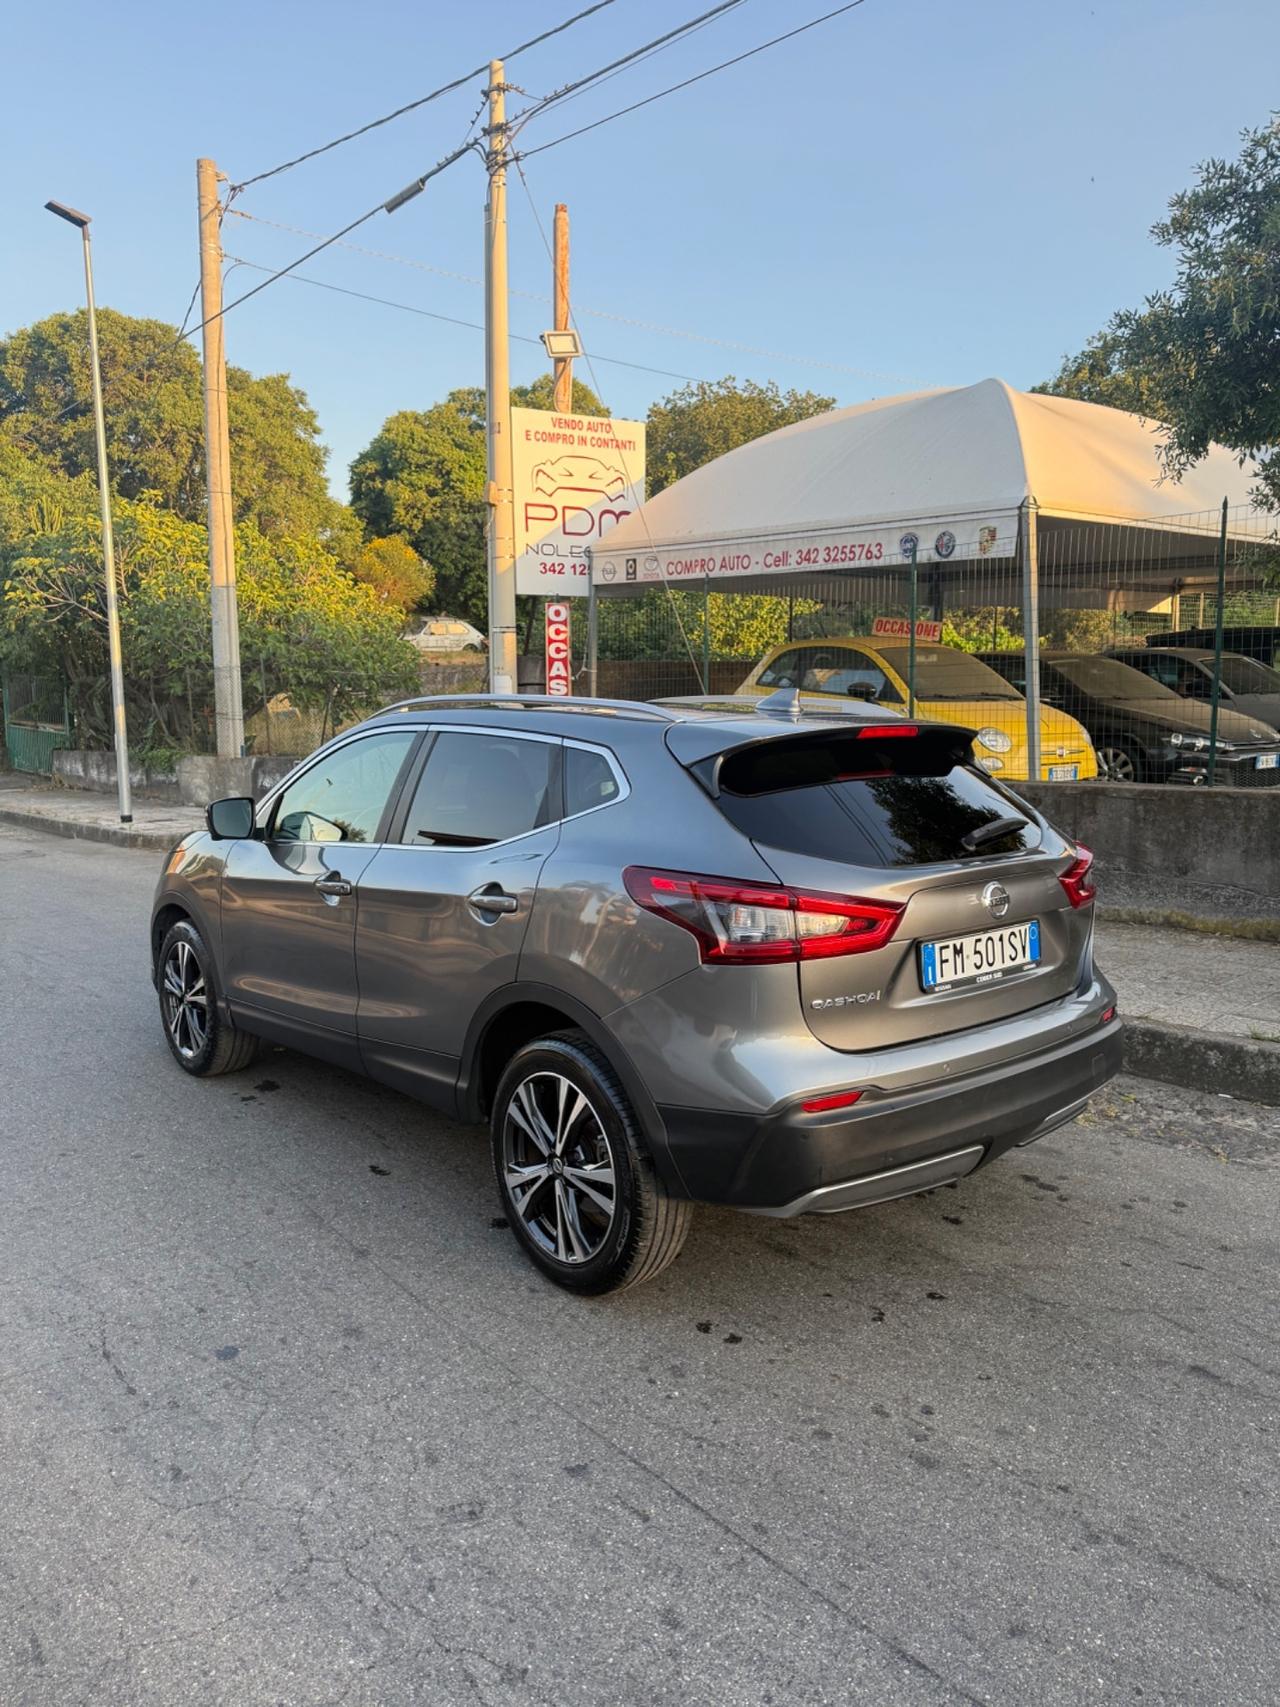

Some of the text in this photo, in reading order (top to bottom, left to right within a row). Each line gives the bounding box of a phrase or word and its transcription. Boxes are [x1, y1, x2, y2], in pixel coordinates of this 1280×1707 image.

[551, 417, 612, 433] VENDO AUTO
[525, 430, 636, 451] E COMPRO IN CONTANTI
[539, 562, 566, 575] 342
[666, 557, 716, 576] COMPRO
[719, 554, 752, 571] AUTO
[763, 550, 792, 568] Cell:
[795, 547, 820, 566] 342
[823, 542, 884, 563] 3255763
[875, 619, 939, 637] OCCASONE
[939, 927, 1028, 978] FM 501SV
